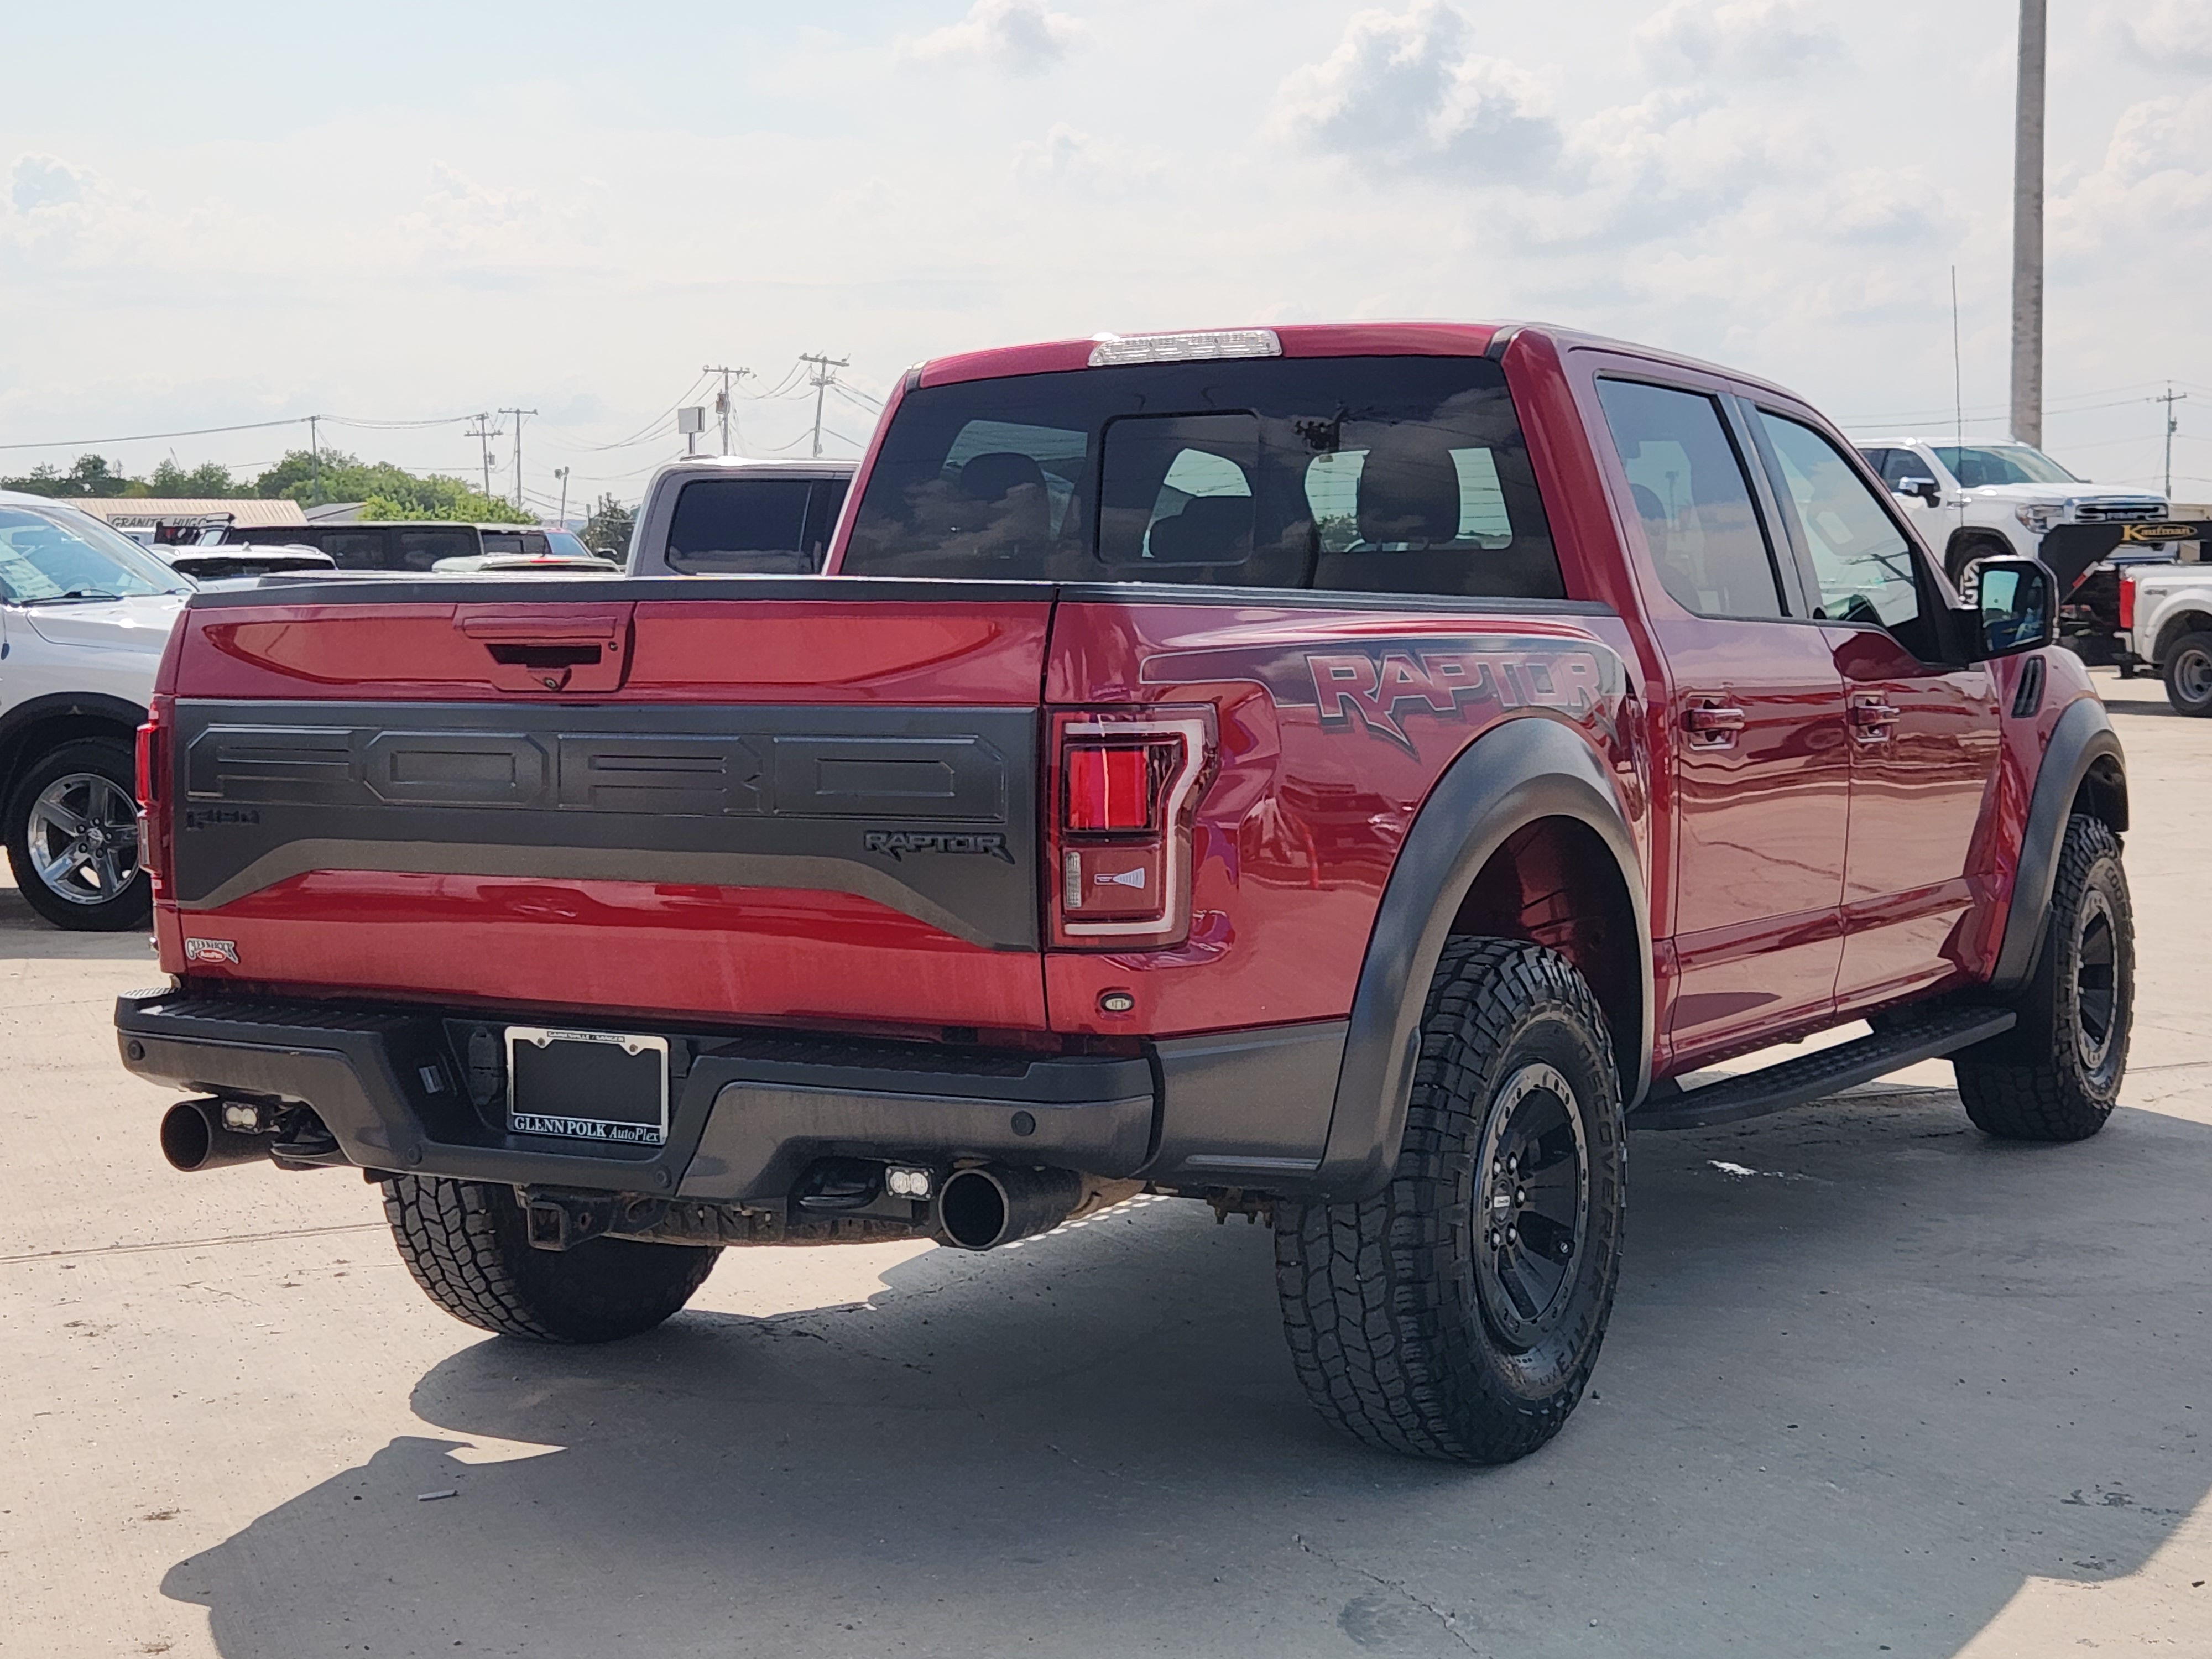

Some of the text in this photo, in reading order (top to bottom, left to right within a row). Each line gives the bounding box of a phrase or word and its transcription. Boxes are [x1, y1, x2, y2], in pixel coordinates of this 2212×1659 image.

[1306, 653, 1621, 748] RAPTOR
[185, 723, 1006, 822] FORD
[864, 830, 1015, 864] RAPTOR
[514, 1117, 659, 1142] GLENN POLK AutoPlex
